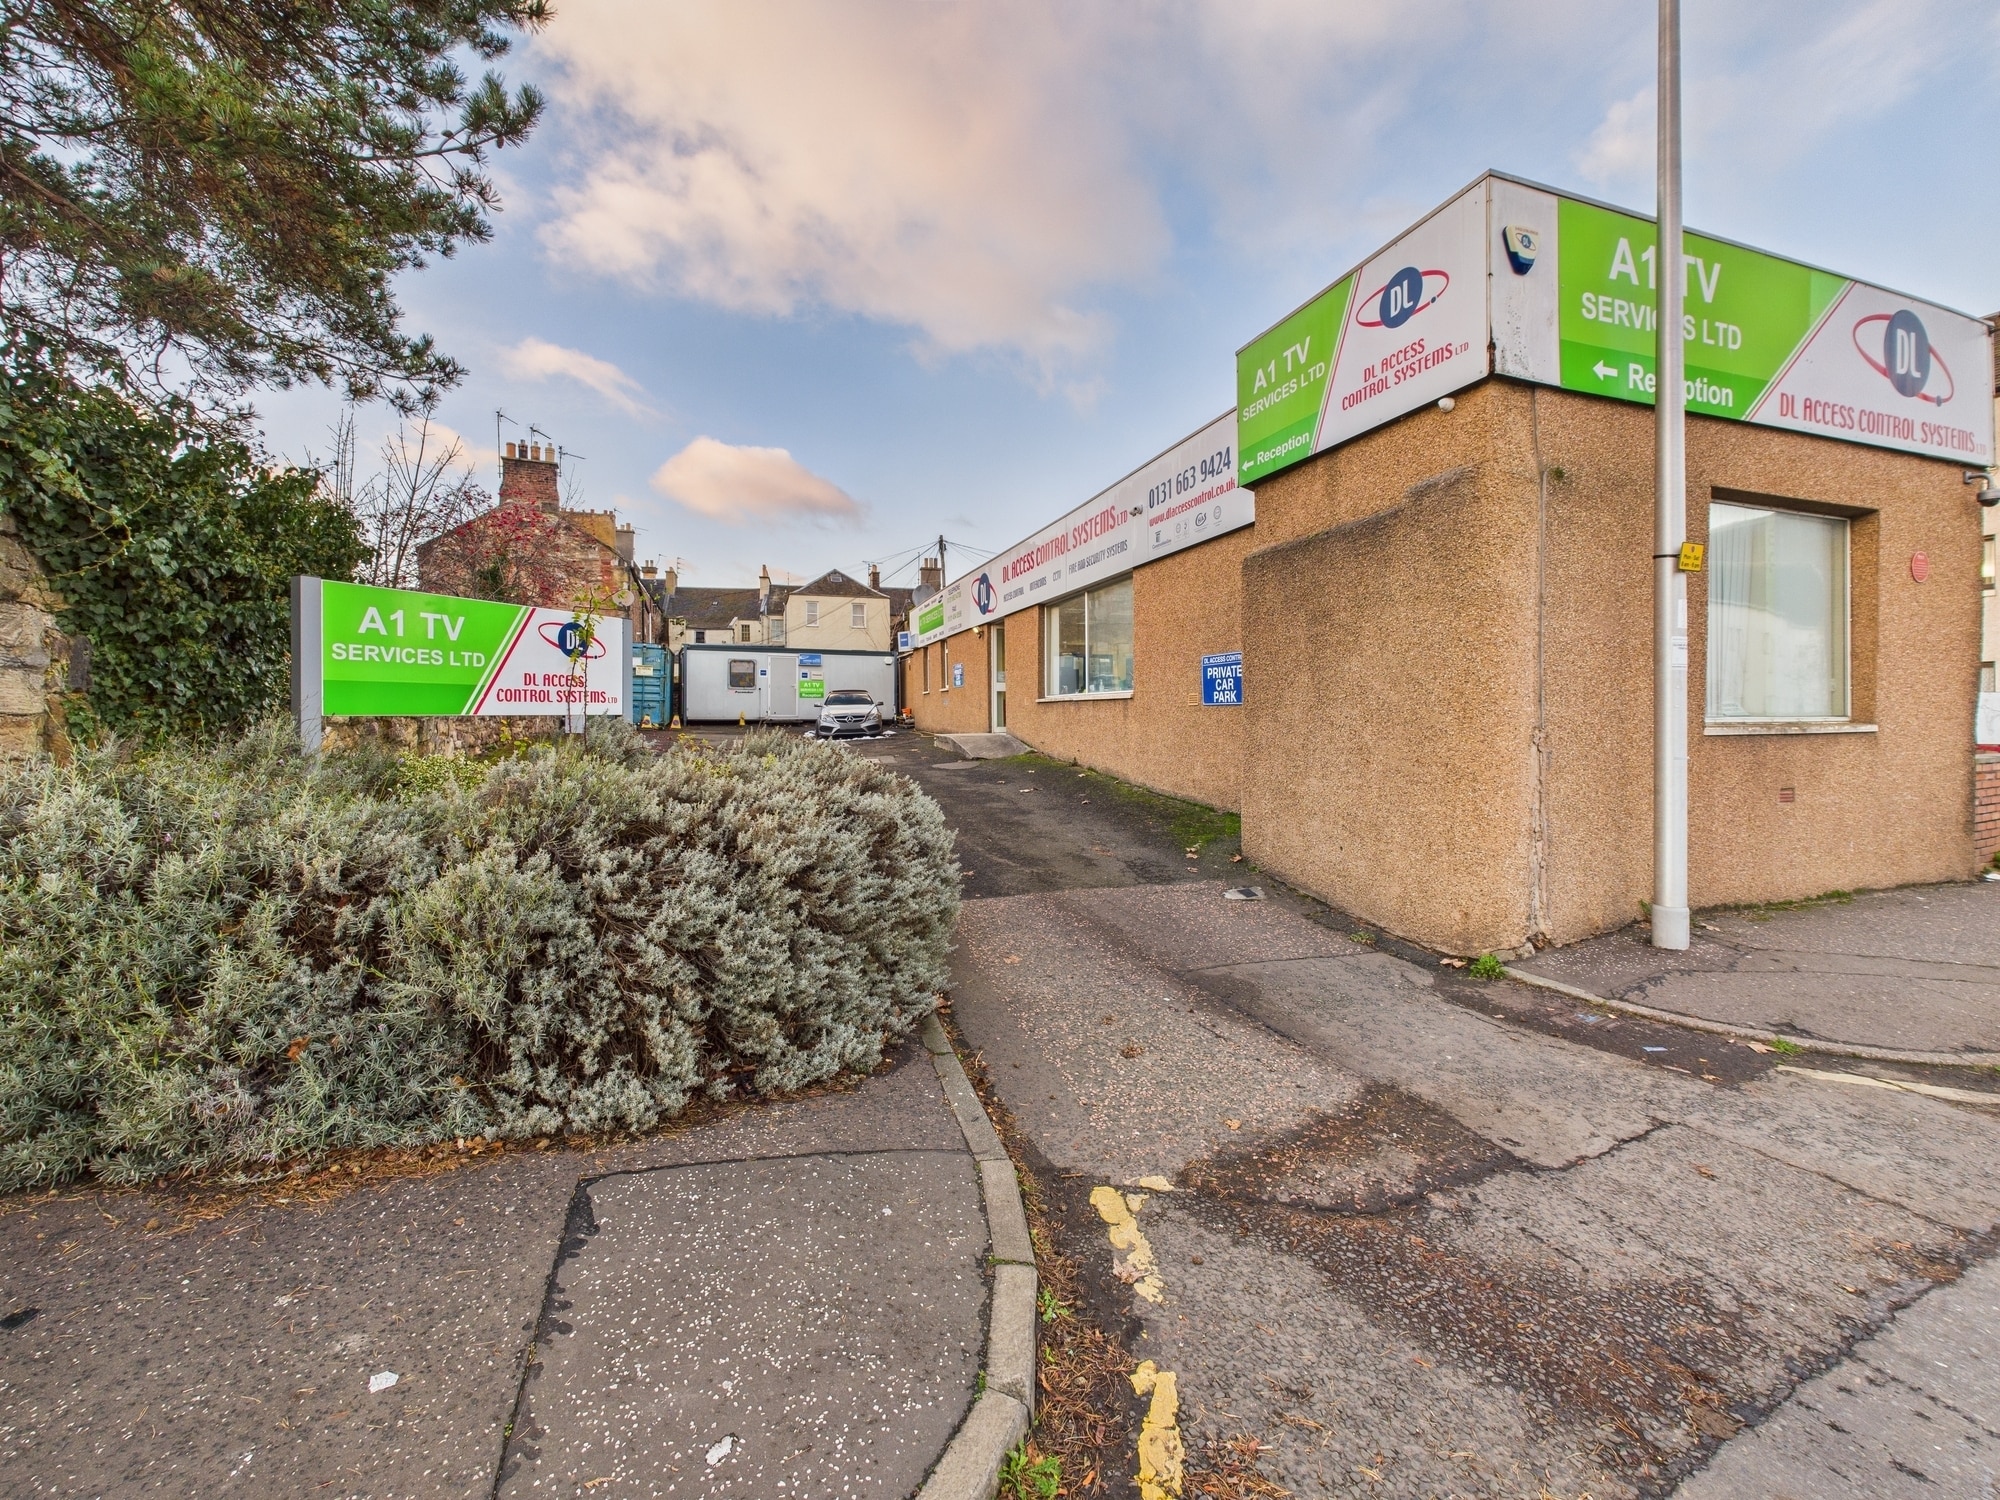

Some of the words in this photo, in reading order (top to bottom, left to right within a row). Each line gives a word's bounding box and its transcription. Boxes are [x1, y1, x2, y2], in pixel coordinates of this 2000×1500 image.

[1609, 237, 1656, 289] A1
[1681, 254, 1721, 303] TV
[1390, 279, 1414, 318] DL
[1582, 292, 1696, 341] SERVIS
[1703, 320, 1742, 350] LTD
[1253, 359, 1275, 394] A1
[1283, 335, 1311, 373] TV
[1364, 364, 1378, 383] DL
[1381, 338, 1425, 374] ACCESS
[1897, 328, 1921, 378] DL
[1242, 378, 1297, 421] SERVICES
[1301, 362, 1325, 388] LTD
[1342, 376, 1391, 411] CONTROL
[1394, 342, 1454, 385] SYSTEMS
[1455, 341, 1469, 356] LTD
[1629, 363, 1733, 407] Reption
[1780, 392, 1798, 419] DL
[1804, 397, 1854, 430] ACCESS
[1859, 409, 1917, 442] CONTROL
[1921, 421, 1975, 453] SYSTEMS
[1257, 432, 1309, 465] Reception
[1149, 478, 1172, 509] 0131
[1175, 465, 1196, 495] 663
[1201, 446, 1231, 482] 9424
[1149, 477, 1236, 527] www.dlaccesscontrol.co.uk
[1002, 564, 1010, 583] DL
[1011, 551, 1035, 580] ACCESS
[1035, 532, 1071, 567] CONTROL
[1072, 505, 1116, 549] SYSTEMS
[1117, 510, 1128, 526] LTD
[1086, 549, 1106, 567] SECURITY
[1106, 539, 1128, 558] SYSTEMS
[980, 583, 988, 606] DL
[357, 606, 404, 637] A1
[419, 611, 466, 642] TV
[566, 629, 584, 650] DL
[331, 642, 444, 666] SERVICES
[449, 650, 486, 668] LTD
[1207, 665, 1242, 679] PRIVATE
[1209, 655, 1226, 663] ACCESS
[496, 688, 553, 703] CONTROL
[556, 689, 606, 704] SYSTEMS
[524, 672, 539, 687] DL
[543, 673, 585, 688] ACCESS
[1213, 690, 1237, 703] PARK
[1215, 678, 1234, 691] CAR
